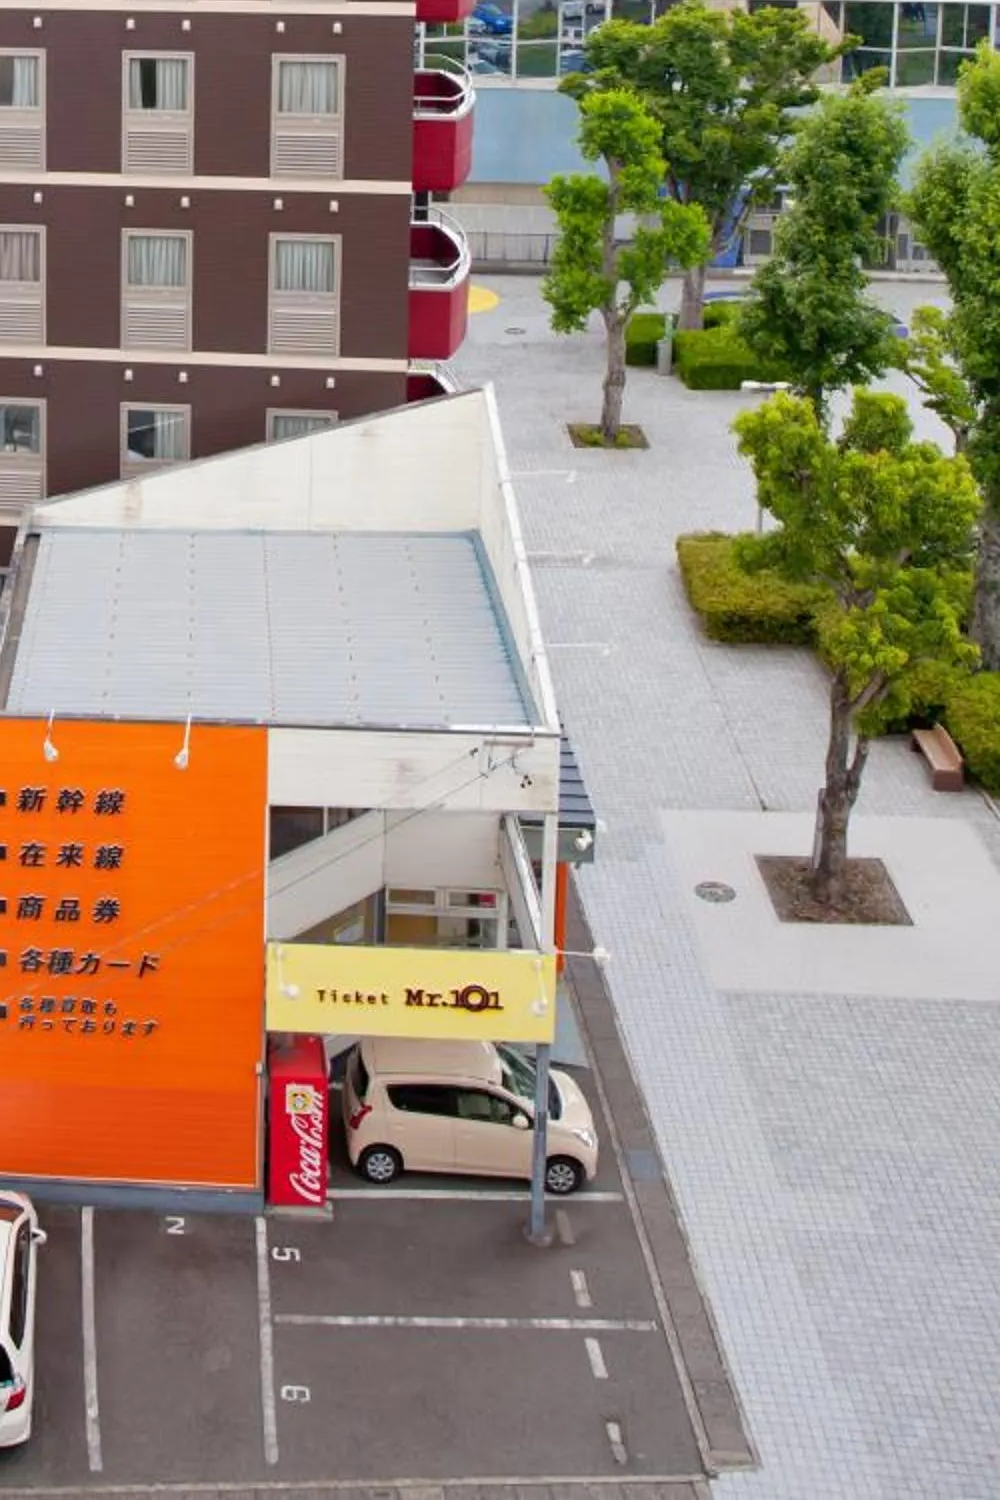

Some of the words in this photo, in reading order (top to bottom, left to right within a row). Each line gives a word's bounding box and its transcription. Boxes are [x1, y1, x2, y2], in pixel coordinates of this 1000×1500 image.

[16, 787, 125, 816] 新幹線
[18, 842, 124, 871] 在来線
[16, 895, 120, 924] 商品券
[19, 947, 160, 978] 各種カード
[316, 988, 390, 1006] Ticket
[272, 1246, 301, 1261] 5
